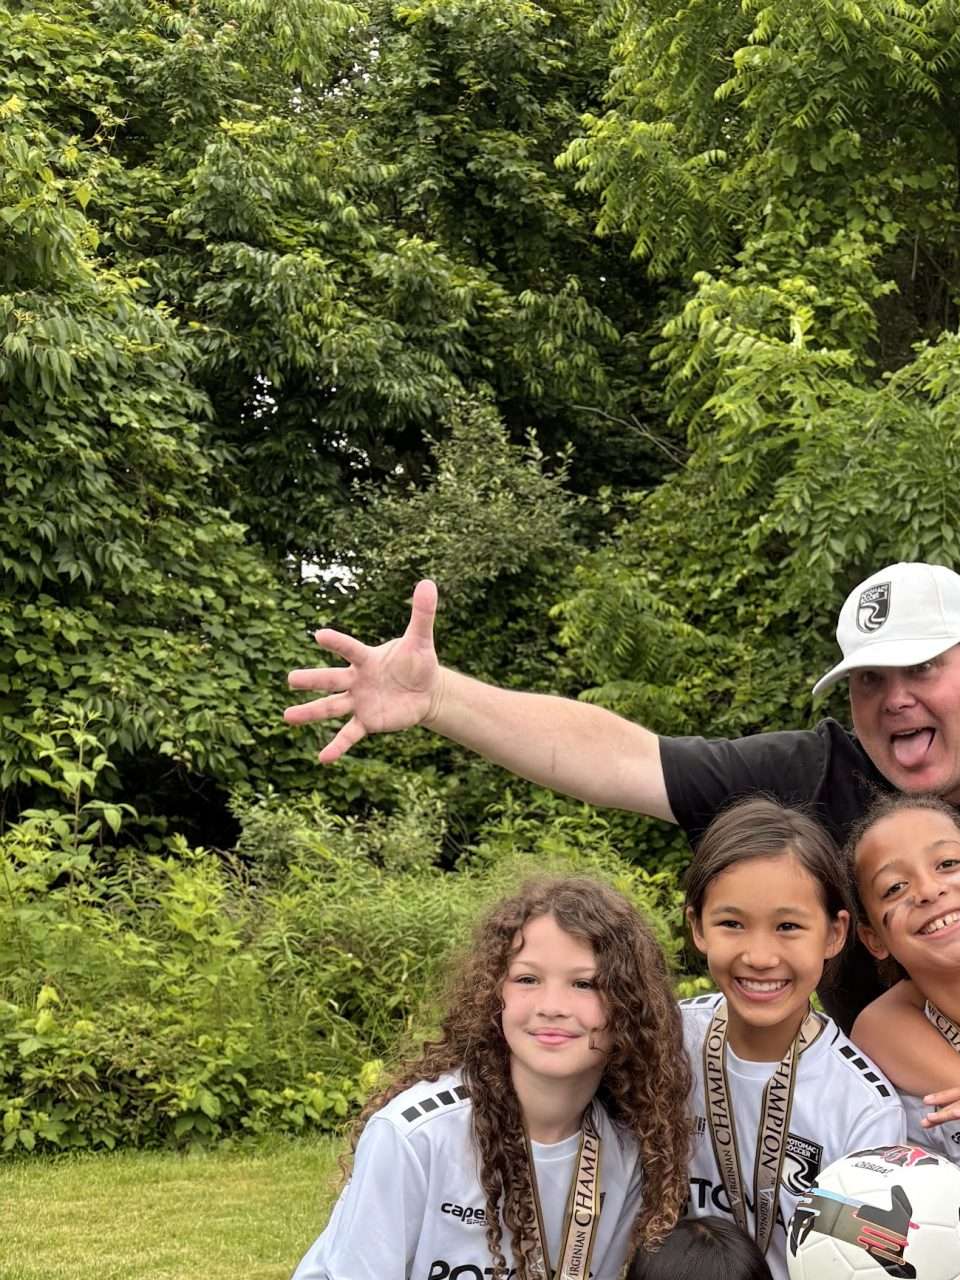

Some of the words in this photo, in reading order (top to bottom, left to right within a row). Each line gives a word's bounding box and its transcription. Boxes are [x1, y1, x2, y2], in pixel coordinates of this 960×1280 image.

[707, 1017, 731, 1146] CHAMPION
[787, 1145, 811, 1157] OCCER
[441, 1202, 486, 1222] cape
